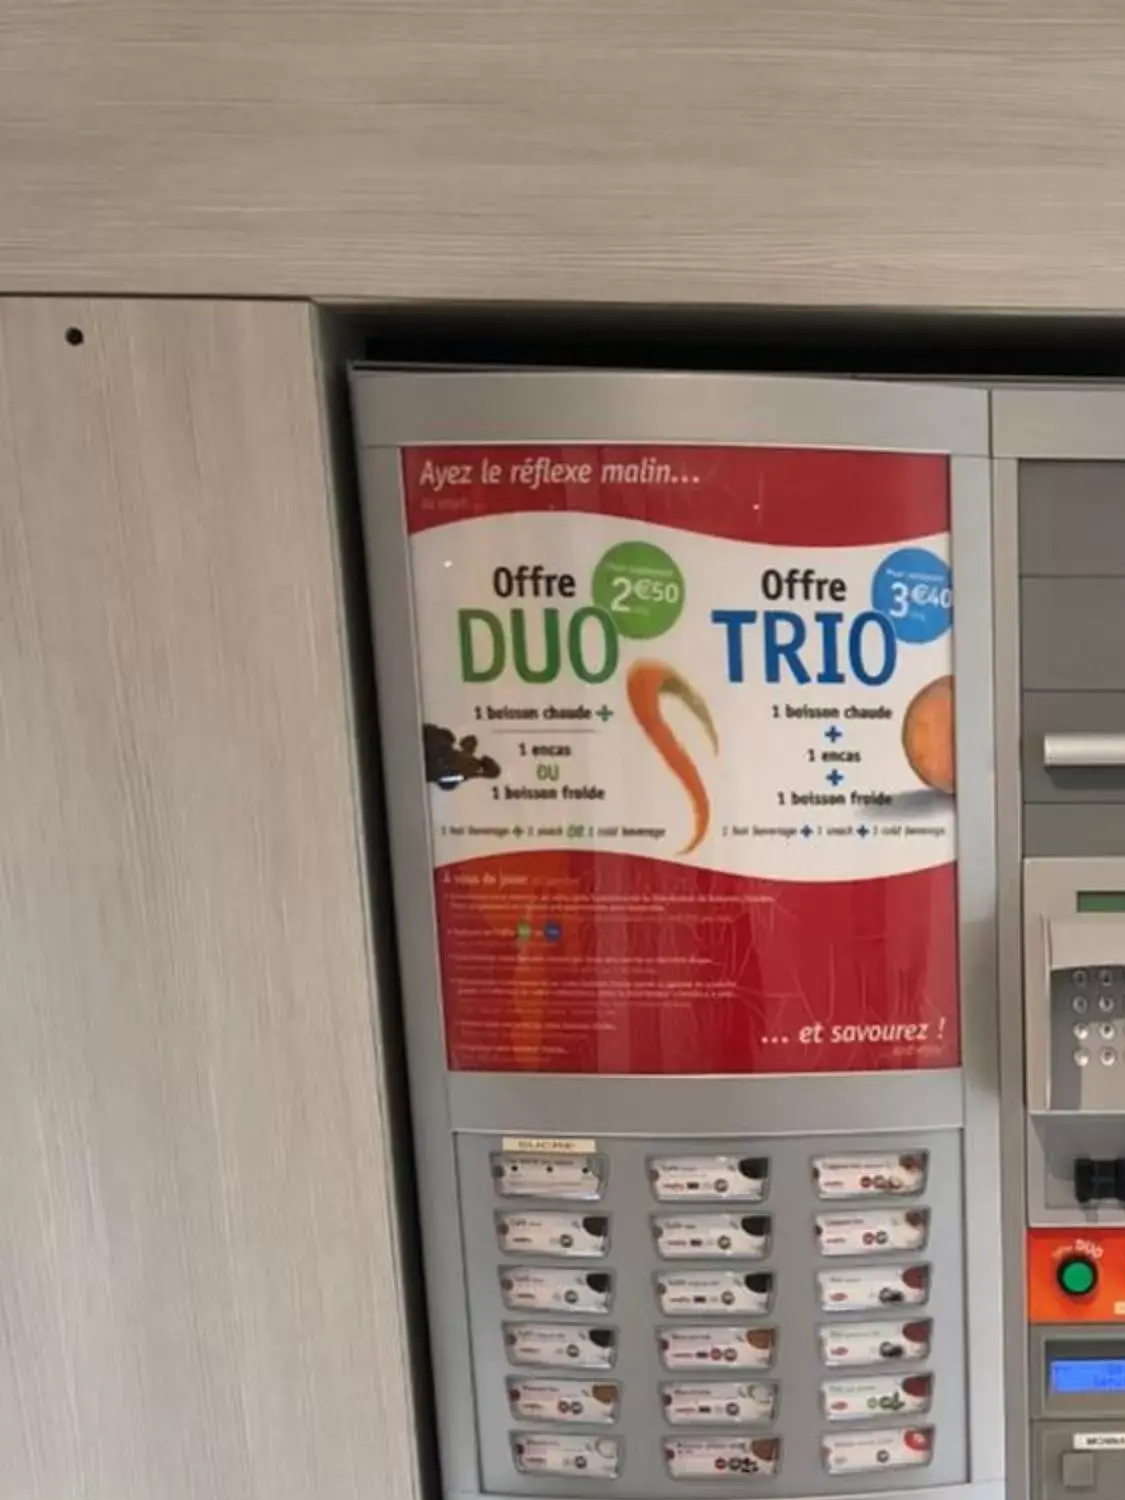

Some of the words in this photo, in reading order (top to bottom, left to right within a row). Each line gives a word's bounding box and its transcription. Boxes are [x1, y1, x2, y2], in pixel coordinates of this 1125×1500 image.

[419, 460, 473, 492] Ayez
[480, 457, 502, 483] le
[510, 457, 592, 490] réflexe
[492, 566, 577, 599] Offre
[761, 568, 847, 602] Offre
[610, 577, 680, 613] 2€50
[889, 581, 953, 619] 3€40
[458, 606, 619, 684] DUO
[711, 608, 898, 688] TRIO
[474, 706, 482, 720] 1
[487, 705, 539, 720] boisson
[543, 705, 593, 720] chaude
[772, 704, 780, 719] 1
[785, 704, 840, 719] boisson
[844, 704, 894, 719] chaude
[519, 742, 527, 756] 1
[532, 744, 572, 756] encas
[808, 748, 816, 762] 1
[821, 750, 862, 763] encas
[536, 764, 560, 781] OU
[492, 786, 500, 800] 1
[504, 785, 558, 800] boisson
[562, 785, 606, 800] froide
[777, 791, 786, 805] 1
[791, 790, 846, 805] boisson
[850, 791, 893, 806] froide
[799, 1022, 825, 1044] et
[830, 1022, 930, 1044] savourez
